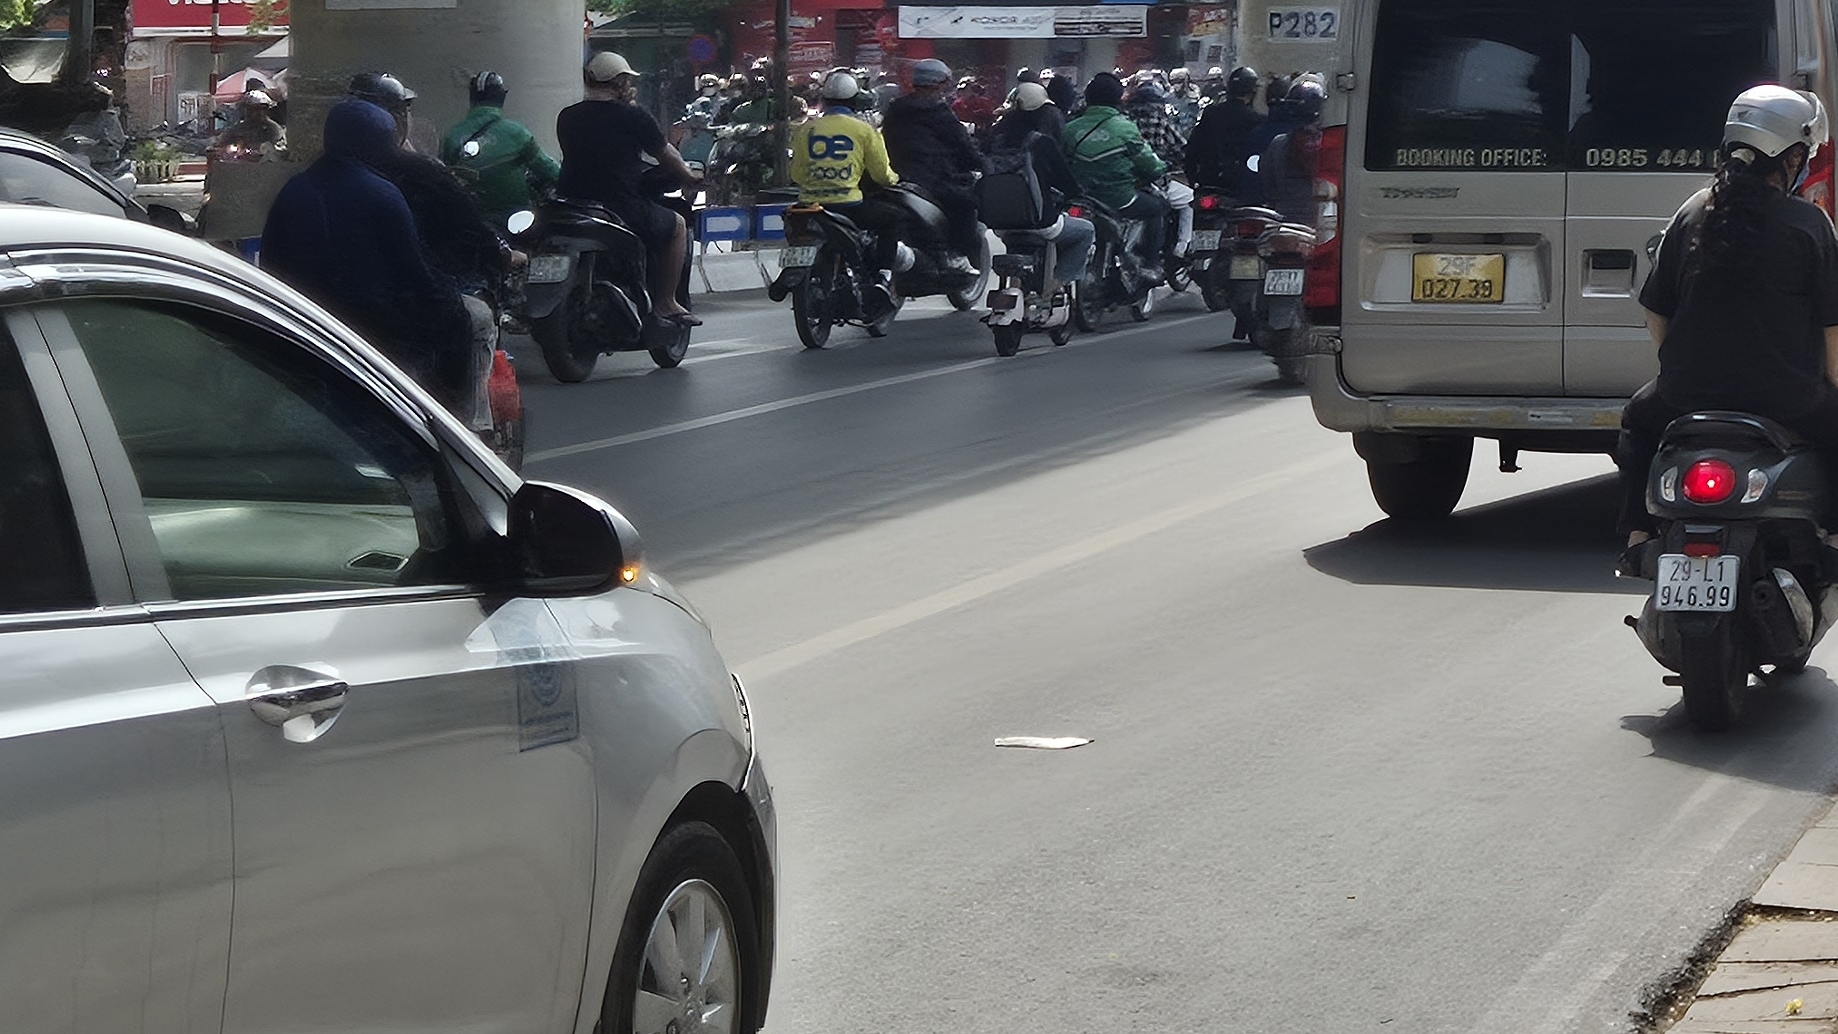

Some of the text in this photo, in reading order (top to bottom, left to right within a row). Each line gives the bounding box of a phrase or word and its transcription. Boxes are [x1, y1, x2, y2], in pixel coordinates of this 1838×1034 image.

[1269, 11, 1336, 40] P282
[807, 128, 854, 161] be
[1396, 148, 1476, 167] BOOKING
[1481, 148, 1548, 167] OFFICE:
[1586, 148, 1648, 167] 0985
[1656, 149, 1704, 167] 444
[1669, 558, 1724, 582] 29-L1
[1660, 584, 1731, 607] 946.99
